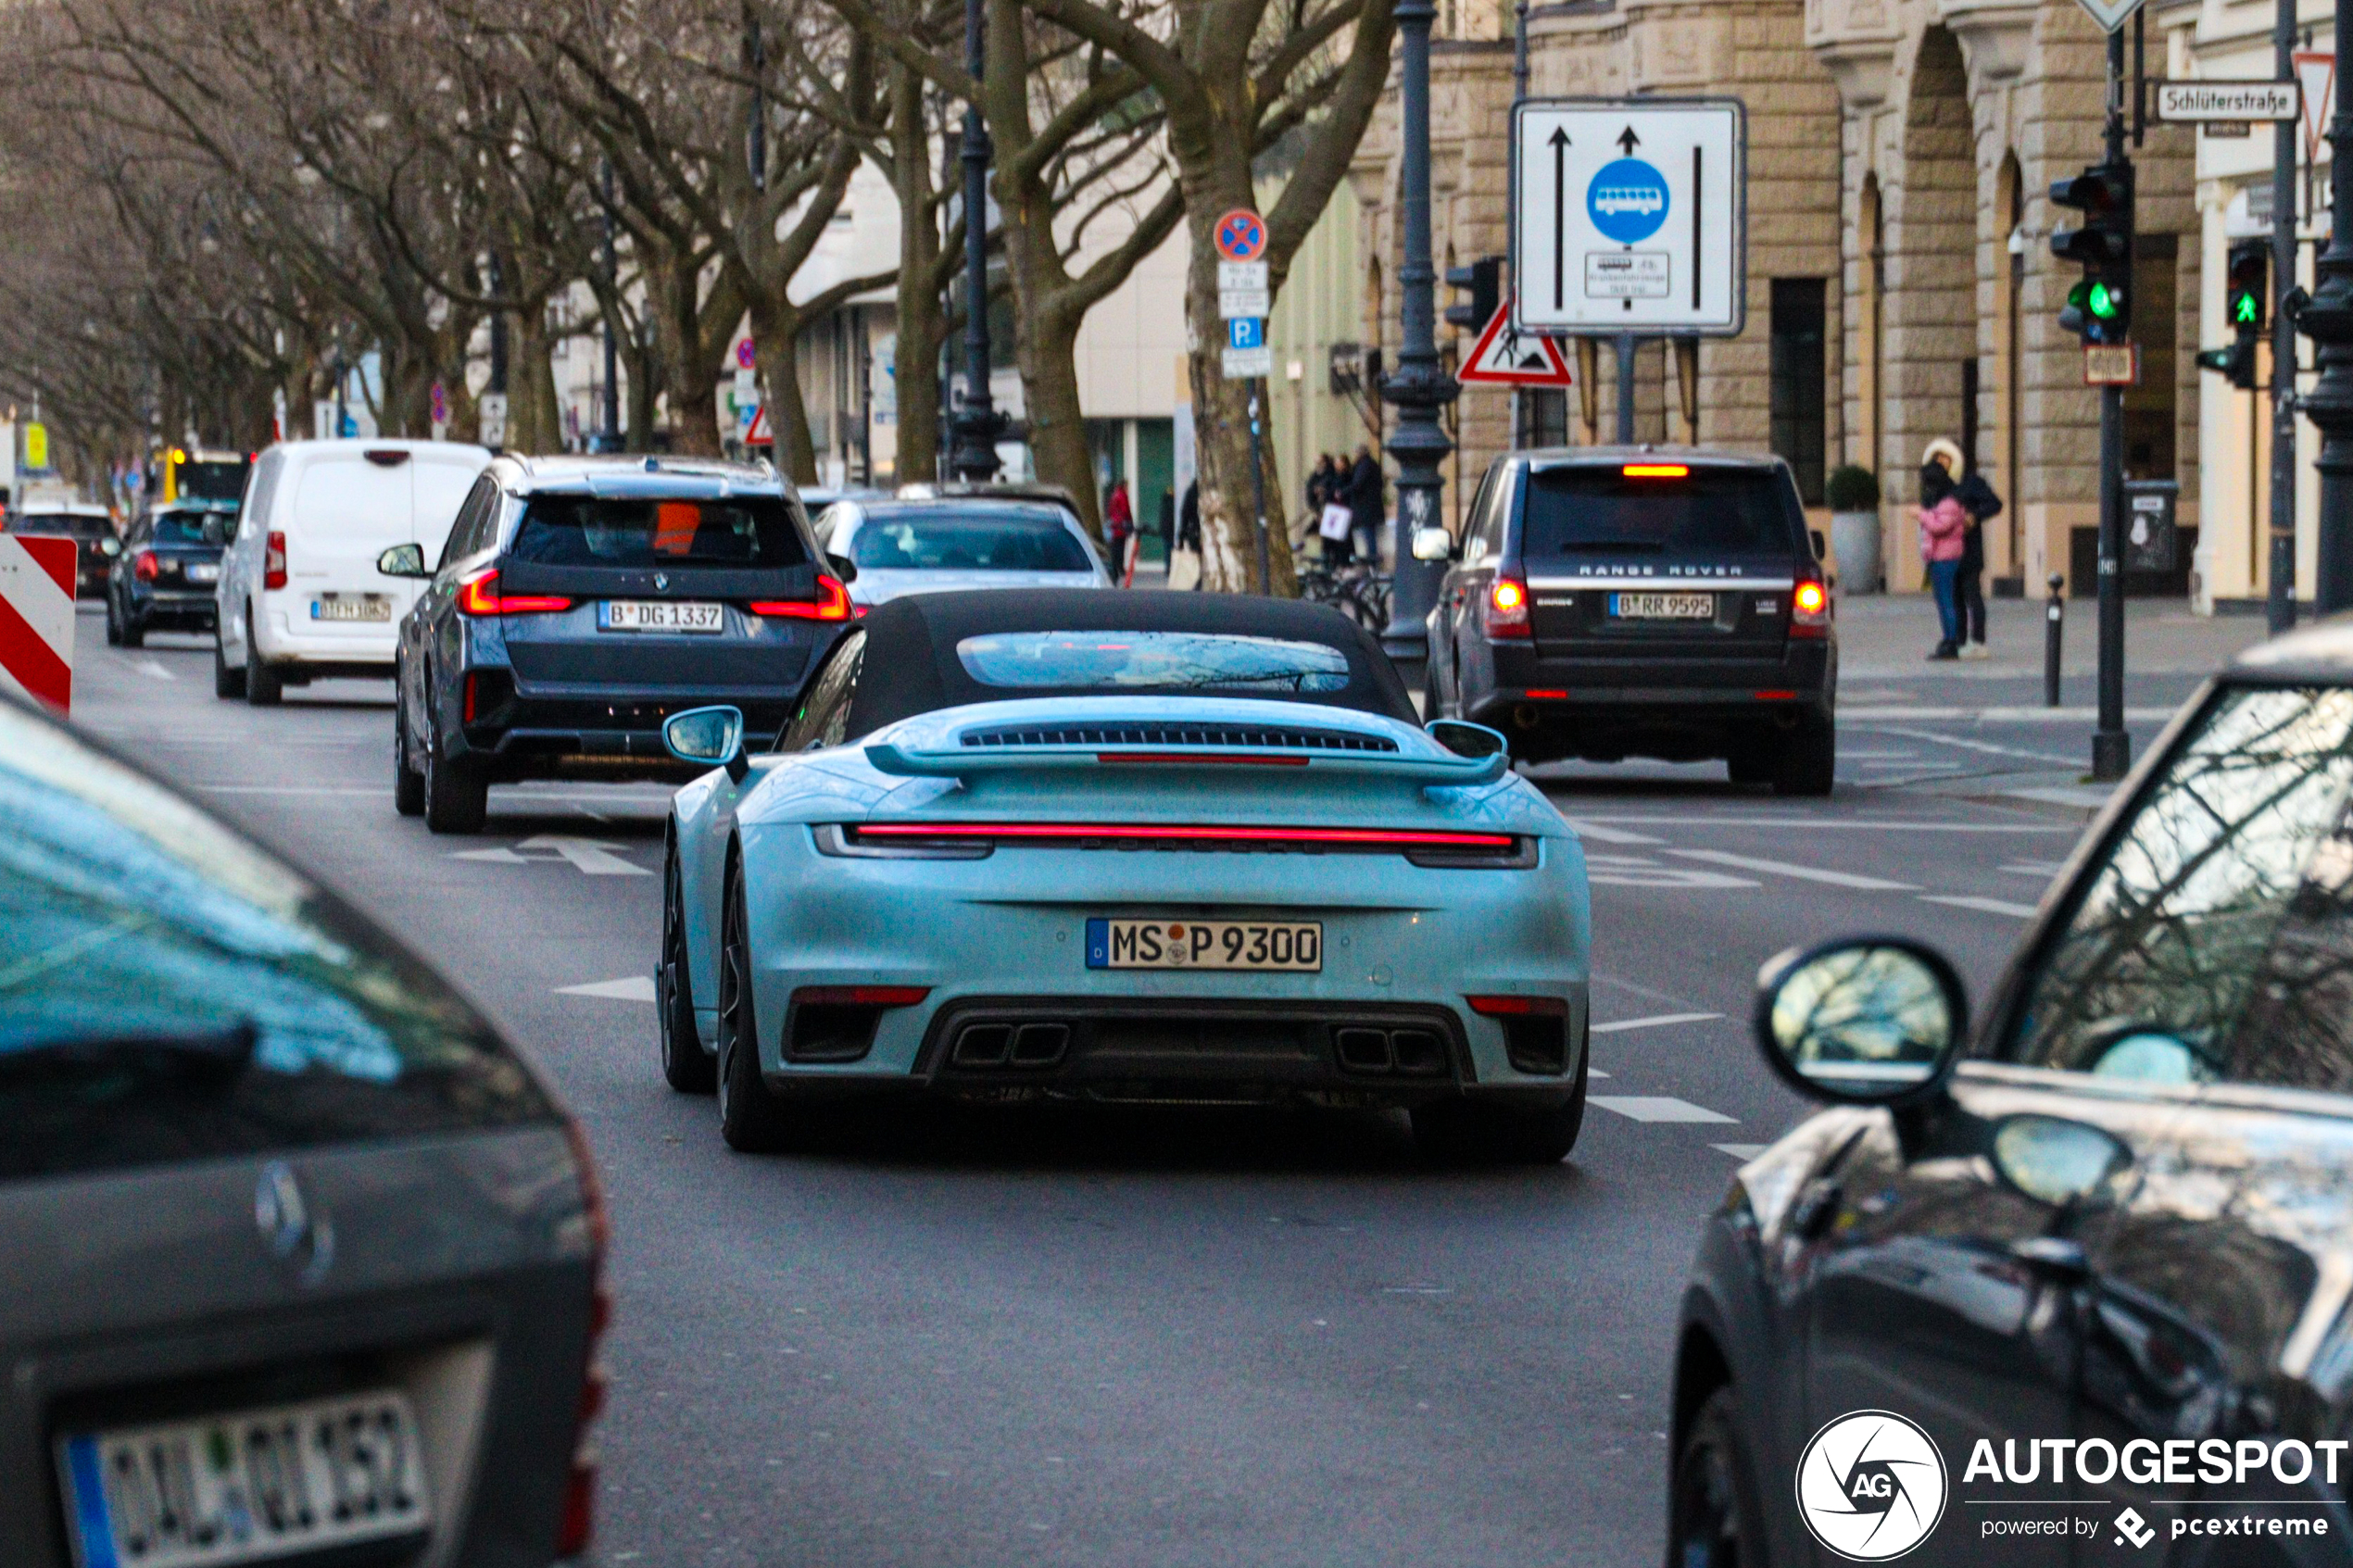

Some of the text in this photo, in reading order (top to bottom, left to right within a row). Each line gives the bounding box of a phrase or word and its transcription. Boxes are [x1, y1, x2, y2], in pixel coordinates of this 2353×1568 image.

[2167, 90, 2287, 114] Schlüterstraße
[1579, 565, 1743, 576] RANGE ROVER
[611, 605, 720, 626] B DG 1337
[1621, 594, 1712, 616] B RR 9595
[1114, 925, 1317, 963] MS P 9300
